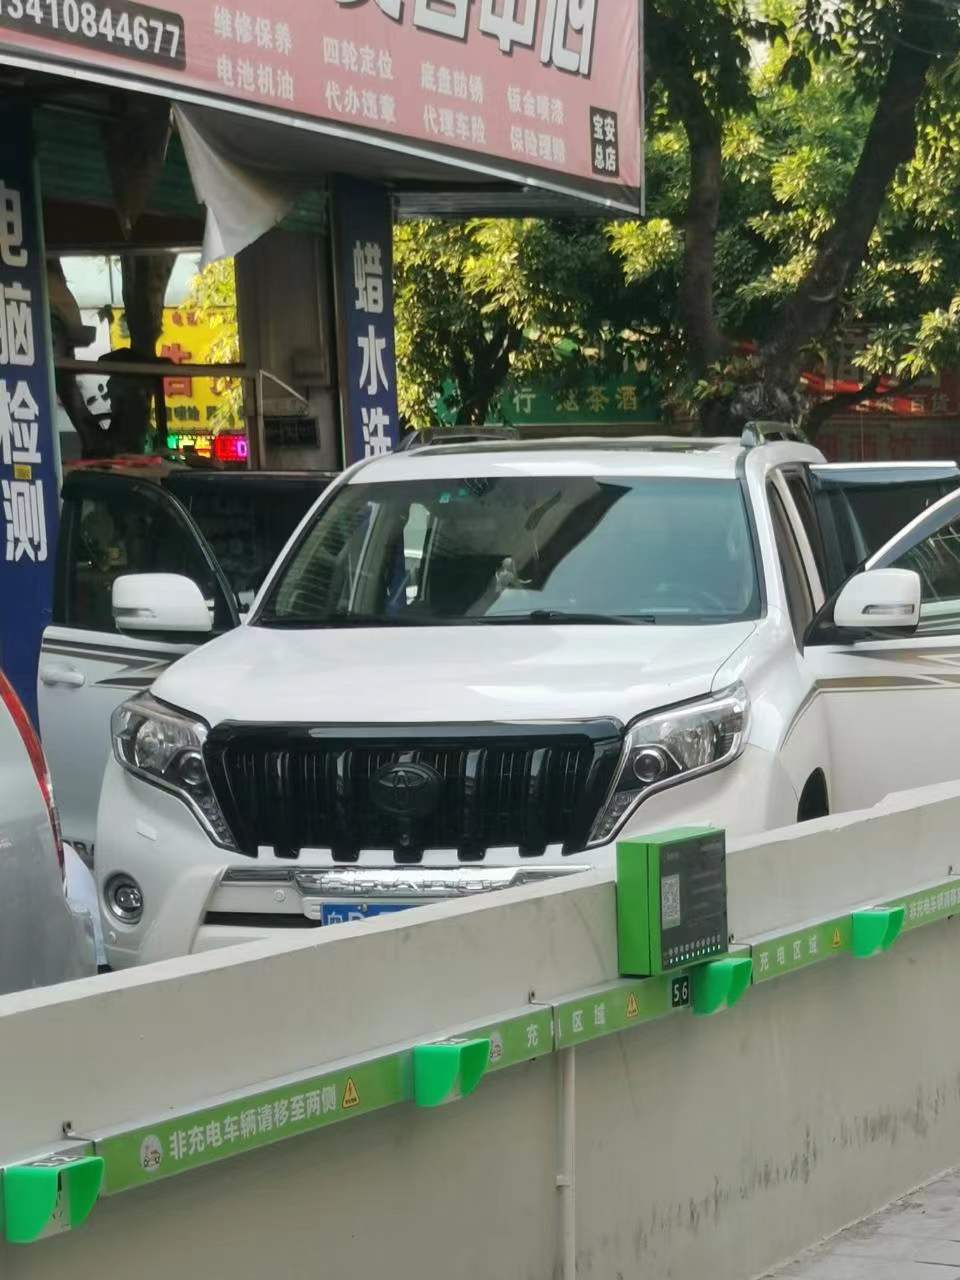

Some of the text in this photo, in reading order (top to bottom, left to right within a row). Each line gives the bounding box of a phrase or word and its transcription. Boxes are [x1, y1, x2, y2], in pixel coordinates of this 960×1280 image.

[0, 0, 180, 58] 3410844677
[214, 6, 292, 56] 维修保养
[217, 55, 294, 101] 电池机油
[323, 35, 394, 80] 四轮定位
[0, 179, 48, 562] 电脑检测
[168, 1083, 337, 1160] 非充电车辆请移至两侧
